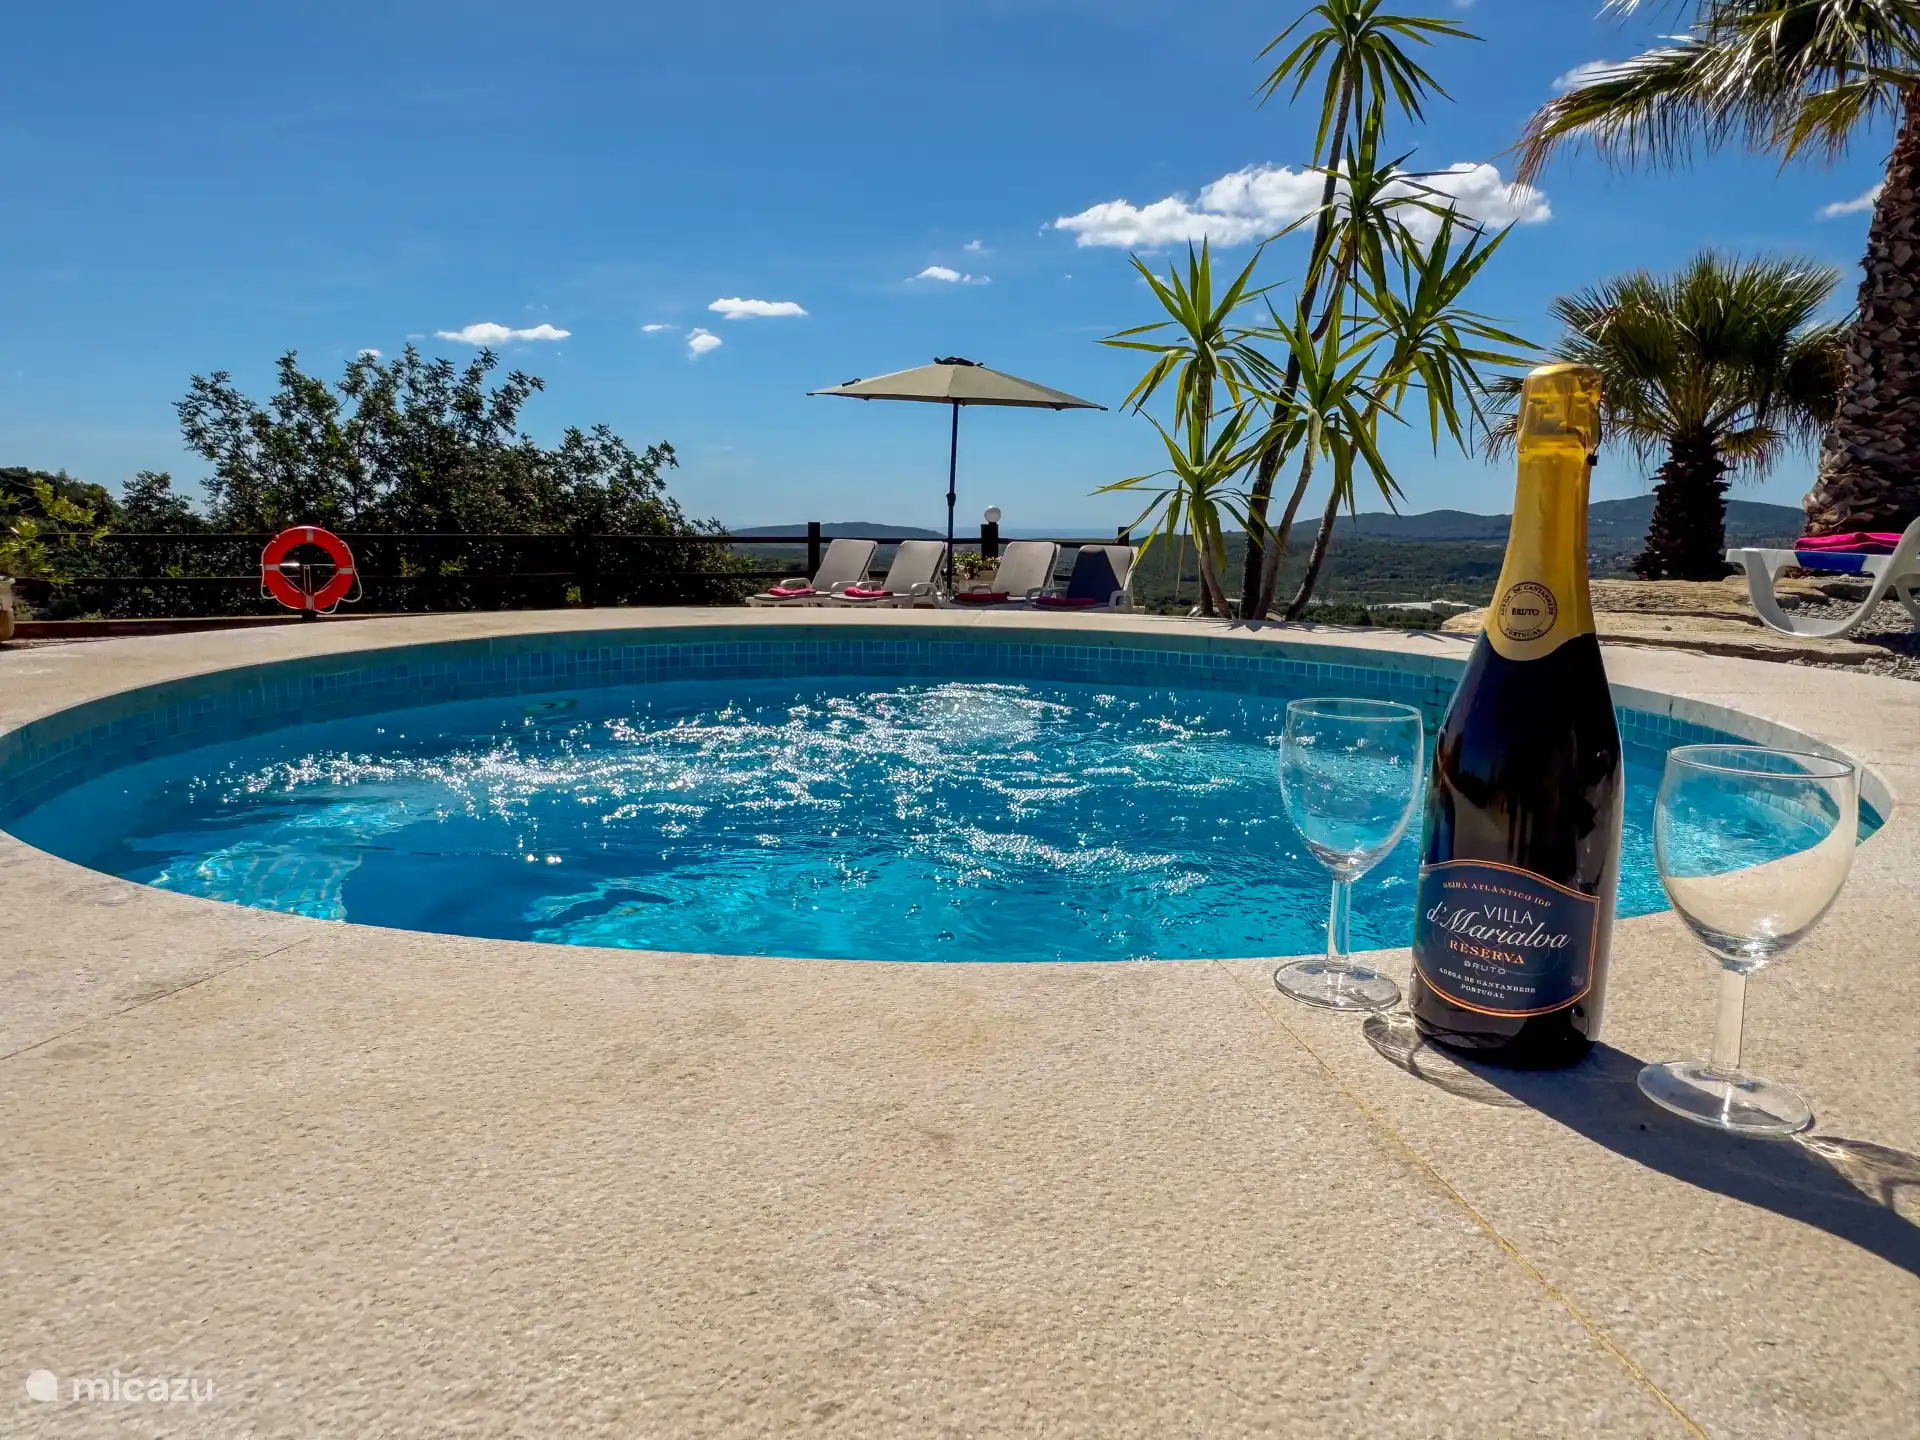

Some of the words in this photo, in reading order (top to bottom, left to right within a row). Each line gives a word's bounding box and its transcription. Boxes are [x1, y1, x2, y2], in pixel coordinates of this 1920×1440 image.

[1511, 607, 1540, 616] BRUTO
[1483, 904, 1534, 926] VILLA
[1449, 940, 1525, 965] RESERVA
[1463, 960, 1506, 975] BRUTO
[1464, 975, 1475, 984] DE
[1460, 983, 1505, 999] PORTUGAL
